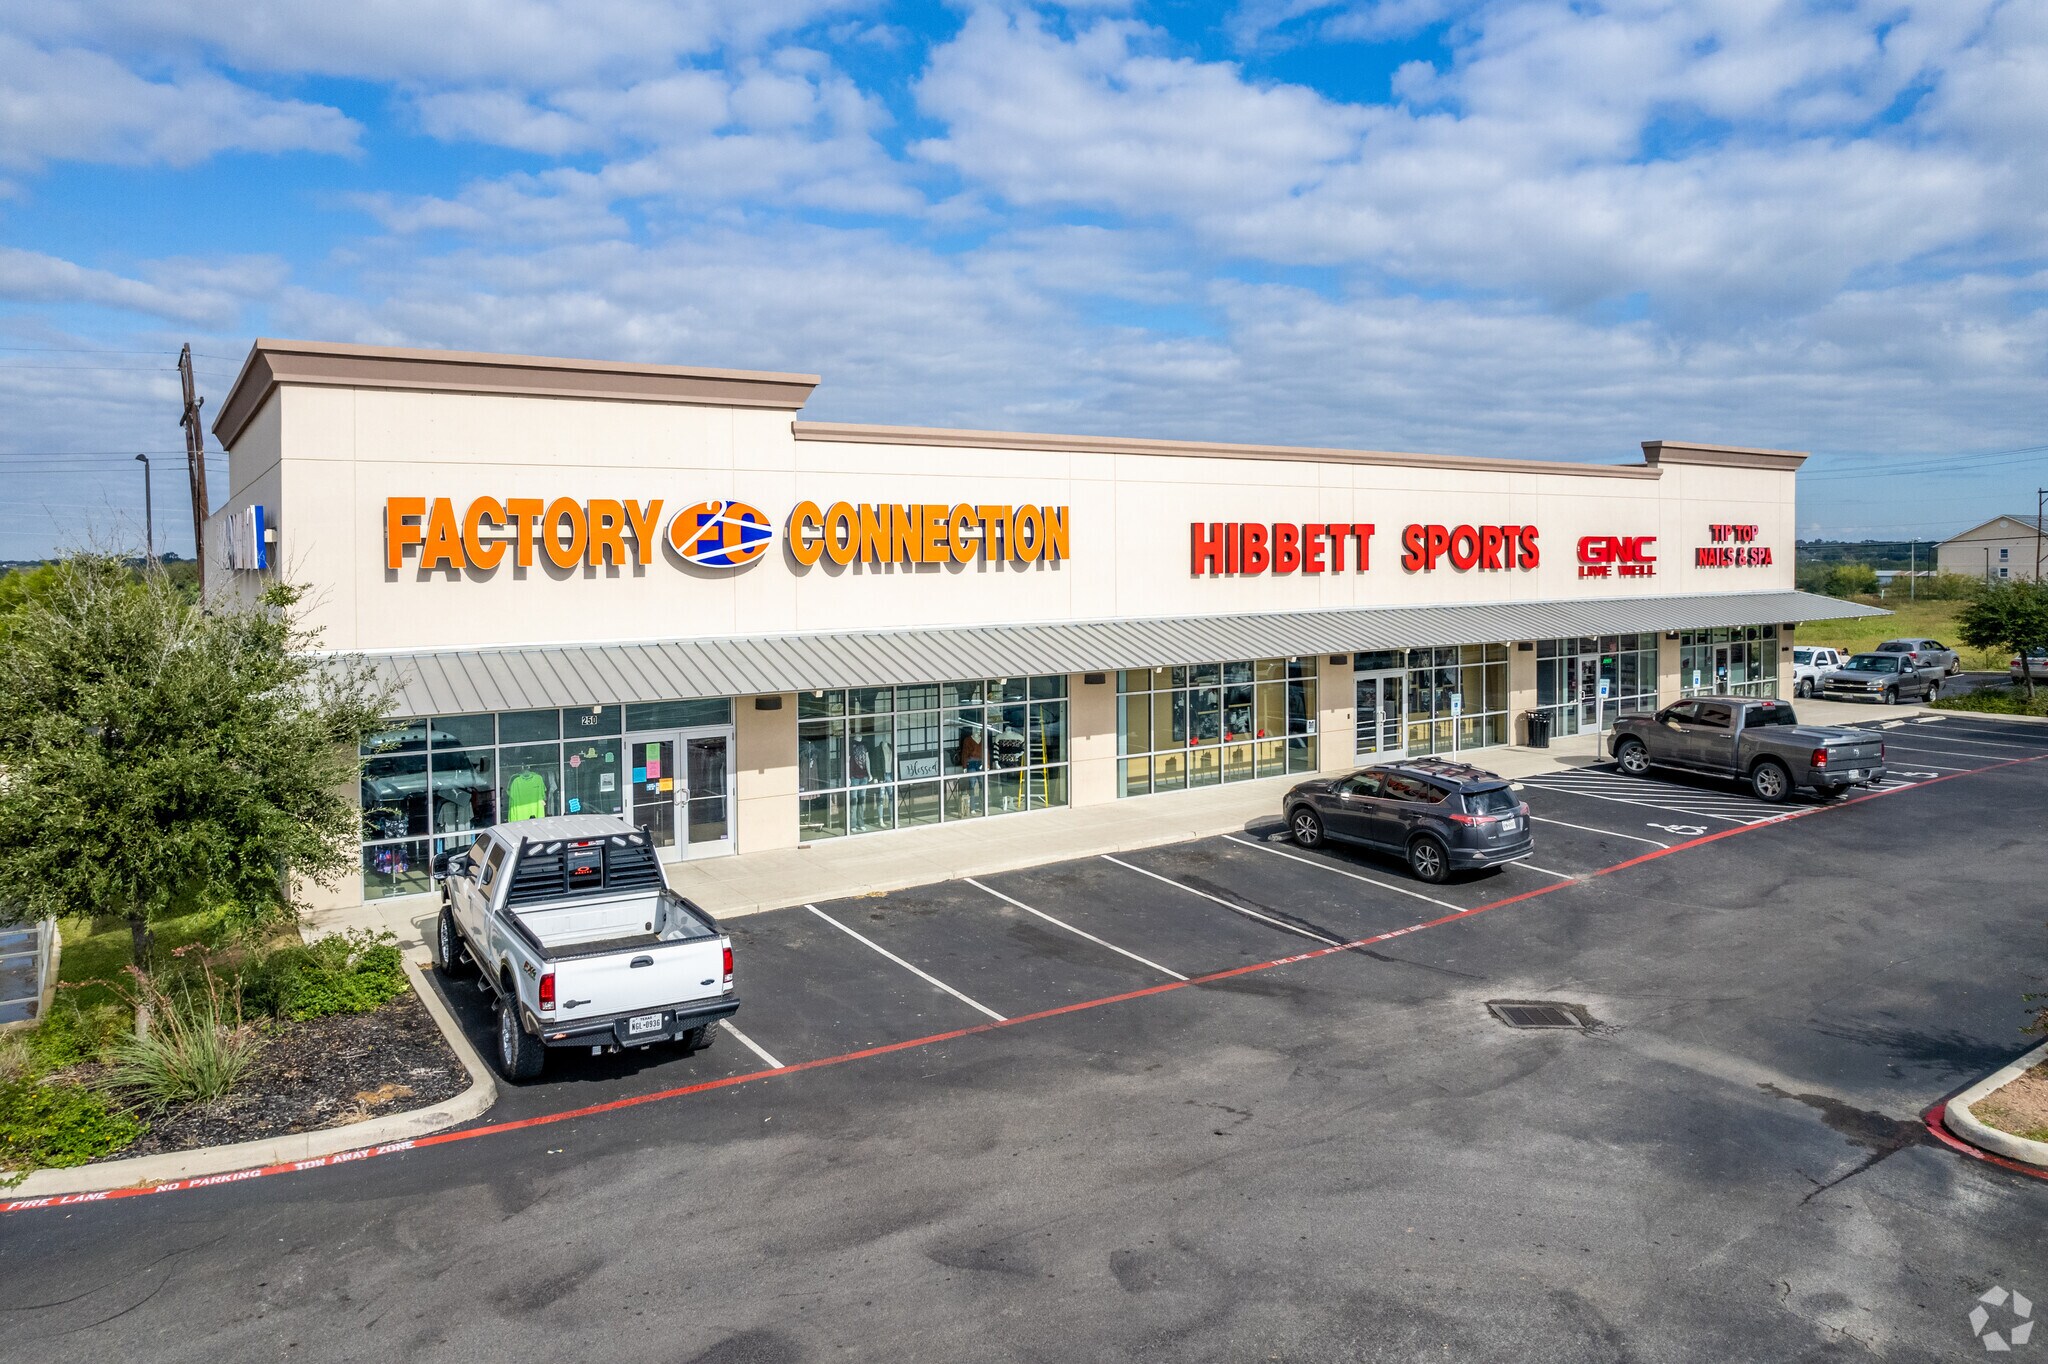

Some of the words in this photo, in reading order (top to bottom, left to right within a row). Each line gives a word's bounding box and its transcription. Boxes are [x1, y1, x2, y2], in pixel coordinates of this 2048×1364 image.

[386, 495, 665, 570] FACTORY
[789, 500, 1070, 565] CONNECTION
[1710, 524, 1733, 542] TIP
[1735, 524, 1759, 542] TOP
[1190, 522, 1375, 575] HIBBETT
[1401, 523, 1540, 572] SPORTS
[1577, 536, 1657, 563] GNC
[1698, 546, 1735, 567] NAILS
[1738, 546, 1747, 566] &
[1750, 546, 1773, 566] SPA
[1578, 565, 1612, 577] LIVE
[1617, 564, 1657, 576] WELL
[581, 715, 598, 726] 250
[906, 760, 937, 776] Blessed
[6, 1197, 54, 1211] FIRE
[60, 1190, 111, 1205] LANE
[155, 1182, 180, 1193] NO
[189, 1169, 262, 1188] PARKING
[294, 1157, 326, 1171] TOW
[331, 1148, 370, 1164] AWAY
[376, 1140, 416, 1155] ZONE
